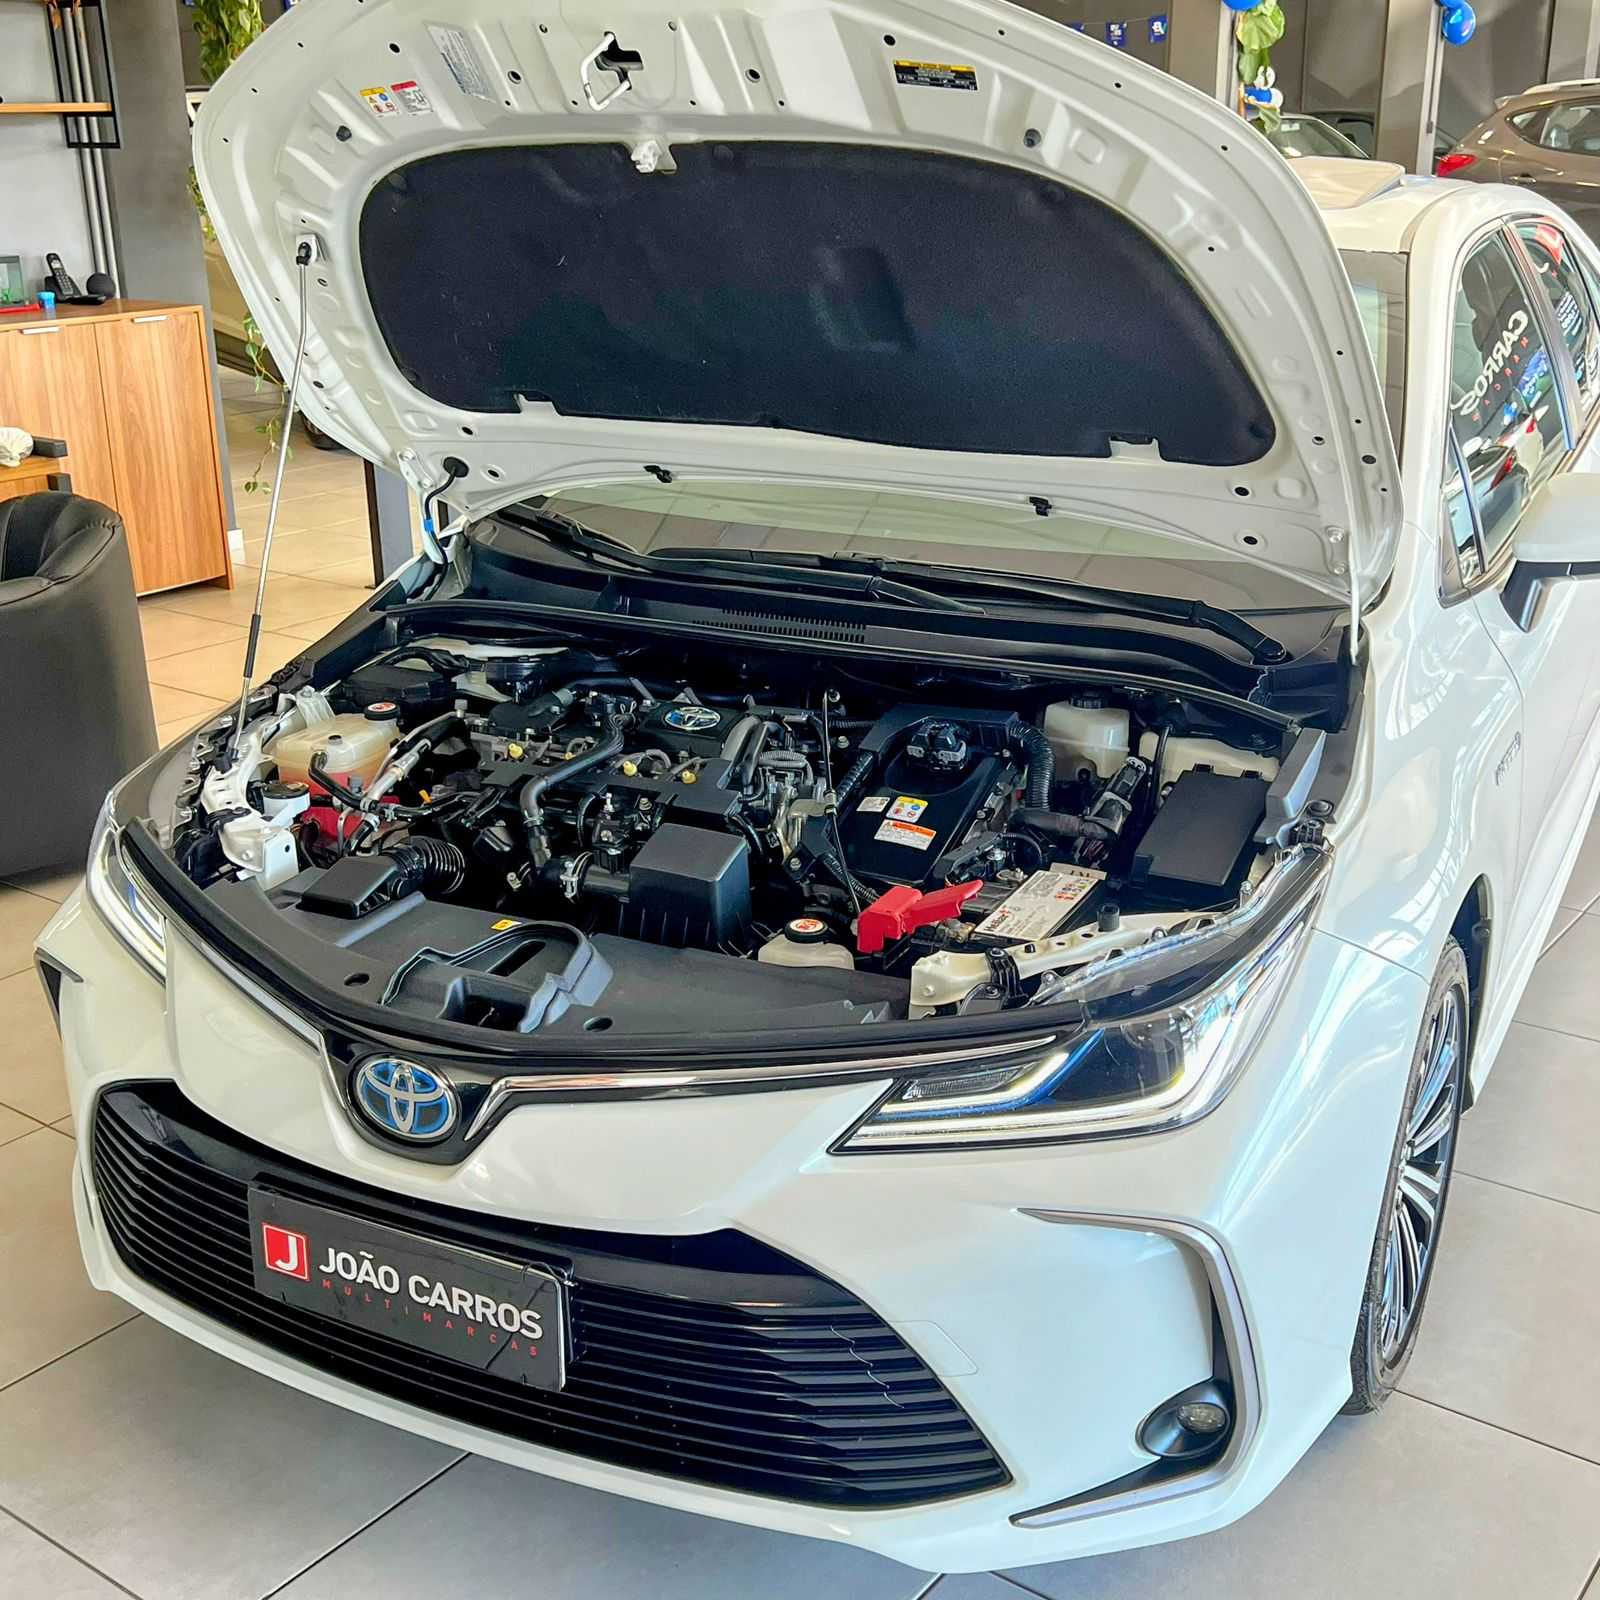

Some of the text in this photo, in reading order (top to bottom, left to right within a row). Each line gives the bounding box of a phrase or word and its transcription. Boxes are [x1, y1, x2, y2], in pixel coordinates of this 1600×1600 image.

[275, 1235, 298, 1272] J
[319, 1247, 544, 1340] JOÃO CARROS
